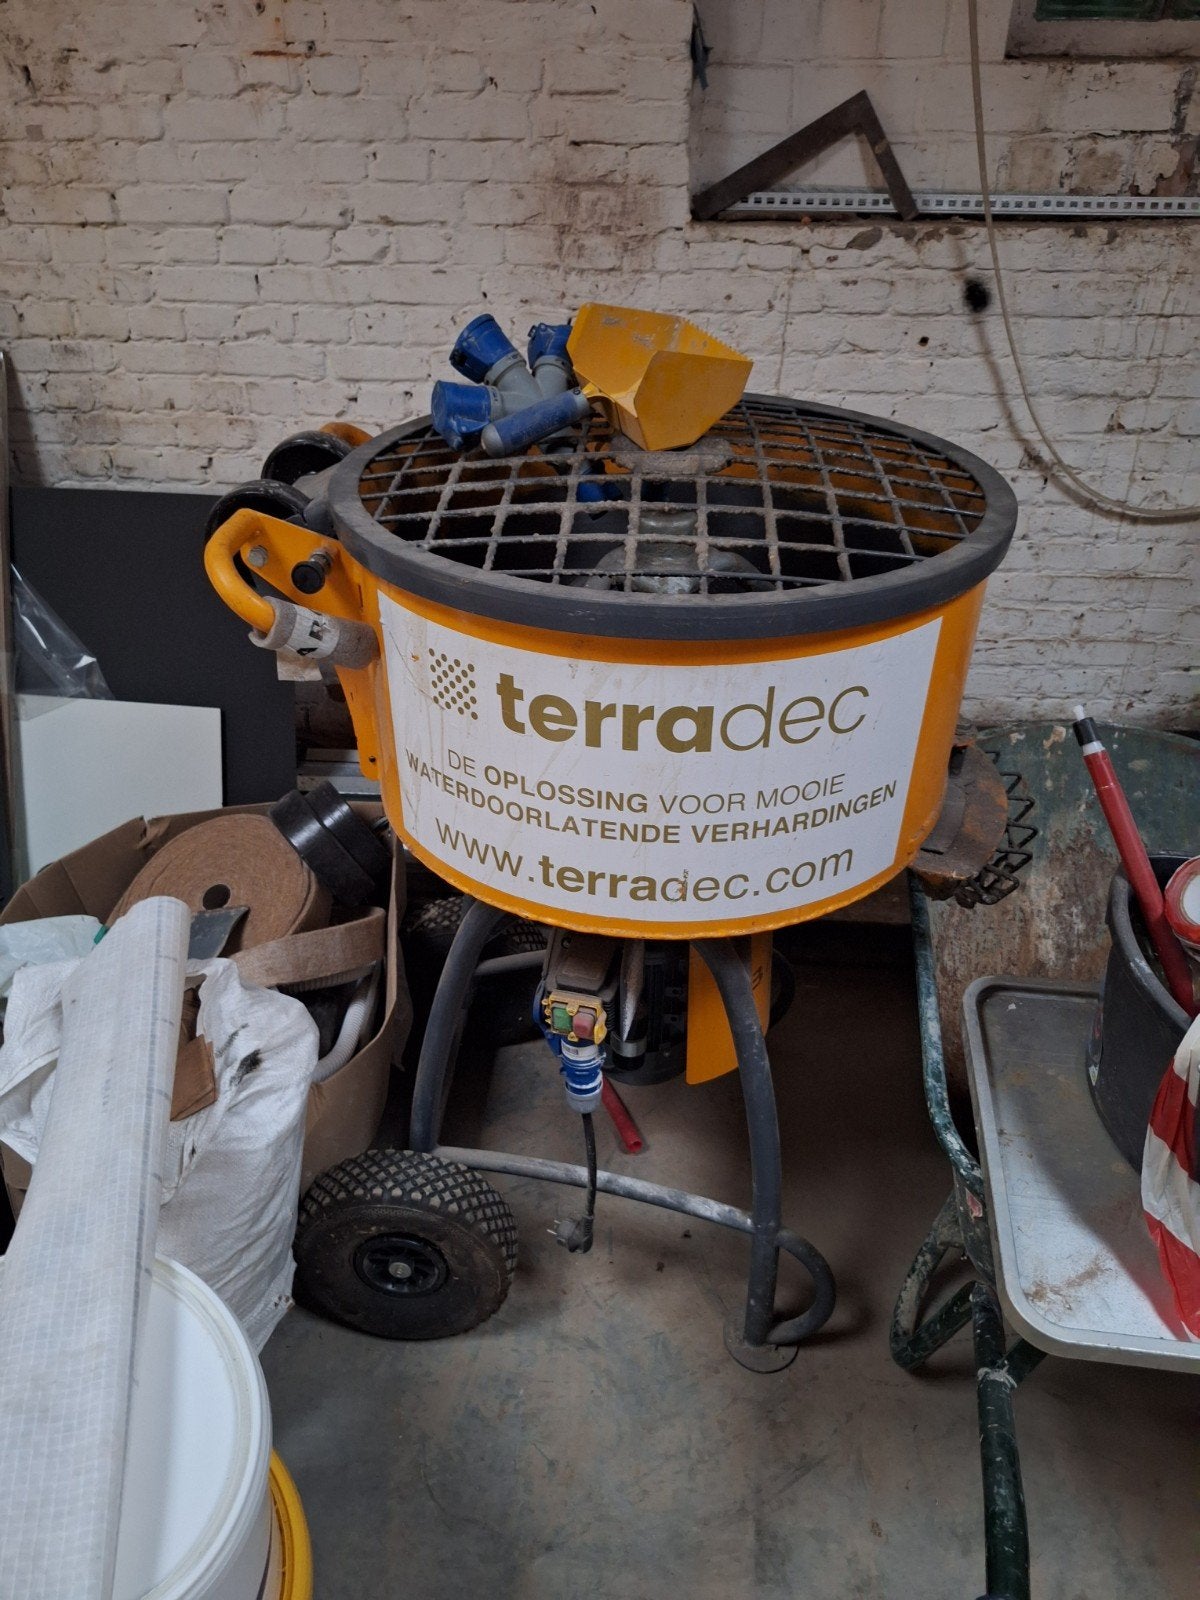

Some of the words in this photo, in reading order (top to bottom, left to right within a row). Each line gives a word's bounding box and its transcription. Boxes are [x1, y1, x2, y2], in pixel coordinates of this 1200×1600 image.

[495, 672, 870, 755] terradec
[405, 748, 681, 845] WATERDOORLATENDE
[691, 780, 898, 844] VERHARDINGEN
[447, 748, 477, 778] DE
[484, 765, 648, 814] OPLOSSING
[659, 792, 746, 815] VOOR
[756, 773, 846, 811] MOOIE
[435, 817, 854, 903] www.terradec.com
